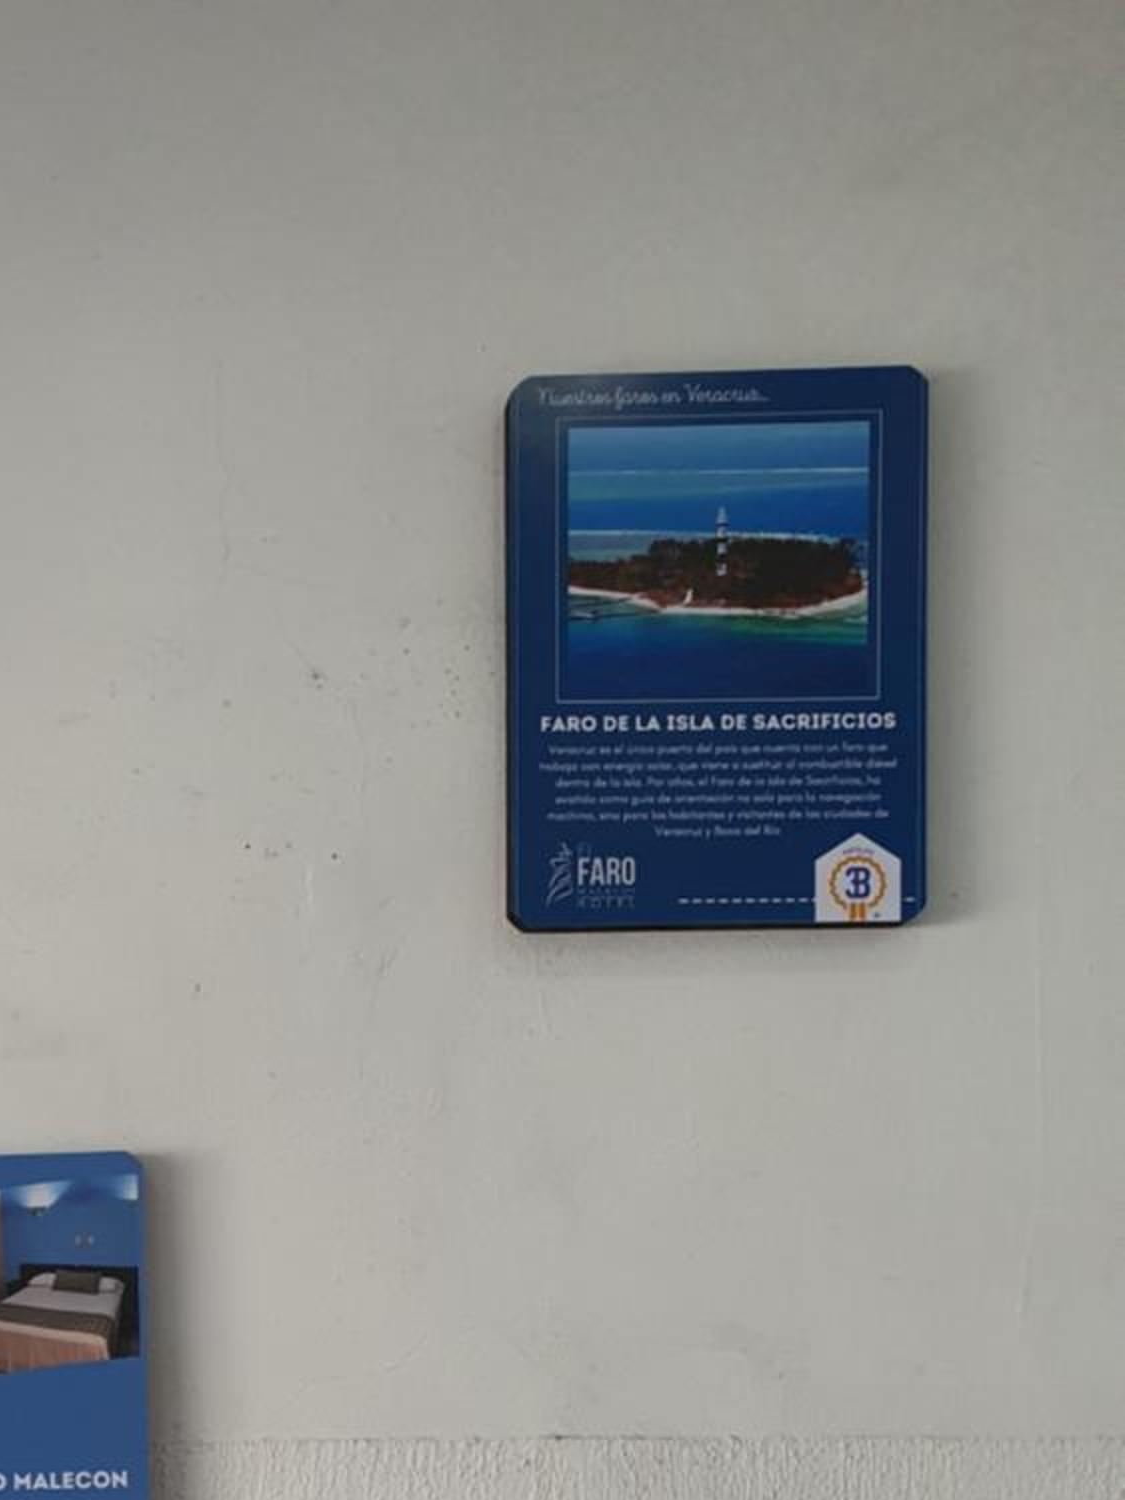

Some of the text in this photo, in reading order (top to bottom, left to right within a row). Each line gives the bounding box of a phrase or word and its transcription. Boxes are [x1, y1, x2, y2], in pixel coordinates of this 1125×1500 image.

[660, 390, 680, 404] en
[540, 712, 897, 733] FARO DE LA ISLA DE SACRIFICIOS
[577, 856, 636, 886] FARO
[13, 1471, 127, 1491] MALECON
